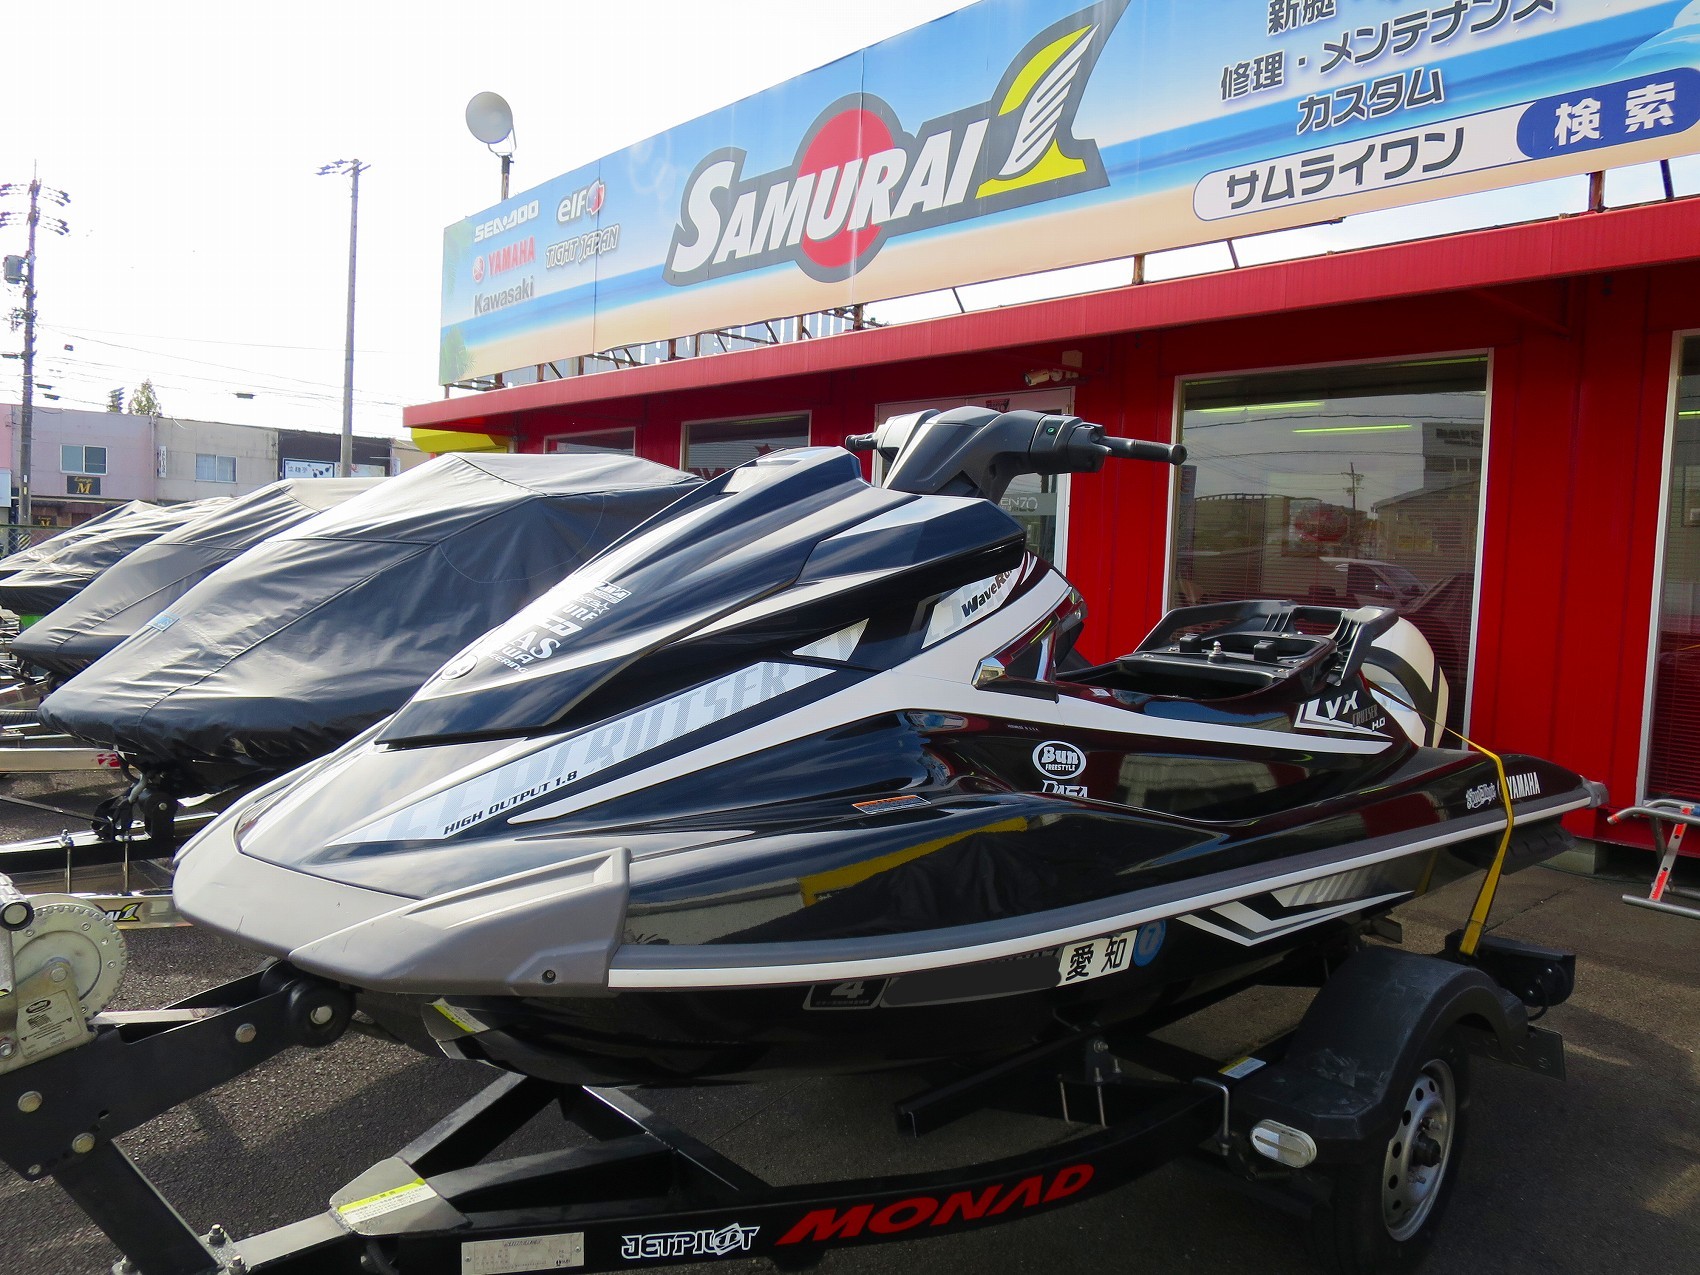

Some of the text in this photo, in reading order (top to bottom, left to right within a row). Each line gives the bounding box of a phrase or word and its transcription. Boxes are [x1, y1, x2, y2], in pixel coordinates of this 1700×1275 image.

[1298, 68, 1444, 133] カスタム
[1226, 81, 1676, 209] サムライワン 検索
[557, 189, 588, 223] elf
[671, 118, 990, 273] SAMURAI
[488, 236, 535, 276] YAMAHA
[546, 224, 620, 269] TIGHT JAPAN
[473, 275, 534, 316] Kawasaki
[1325, 690, 1358, 720] VX
[1041, 746, 1079, 765] Bun
[1045, 764, 1076, 772] FREESTYLE
[443, 770, 578, 835] HIGH OUTPUT 1.8
[1506, 772, 1541, 800] YAMAHA
[1066, 937, 1128, 981] 愛知
[775, 1163, 1095, 1246] MONAD
[621, 1222, 761, 1260] JETPILOT
